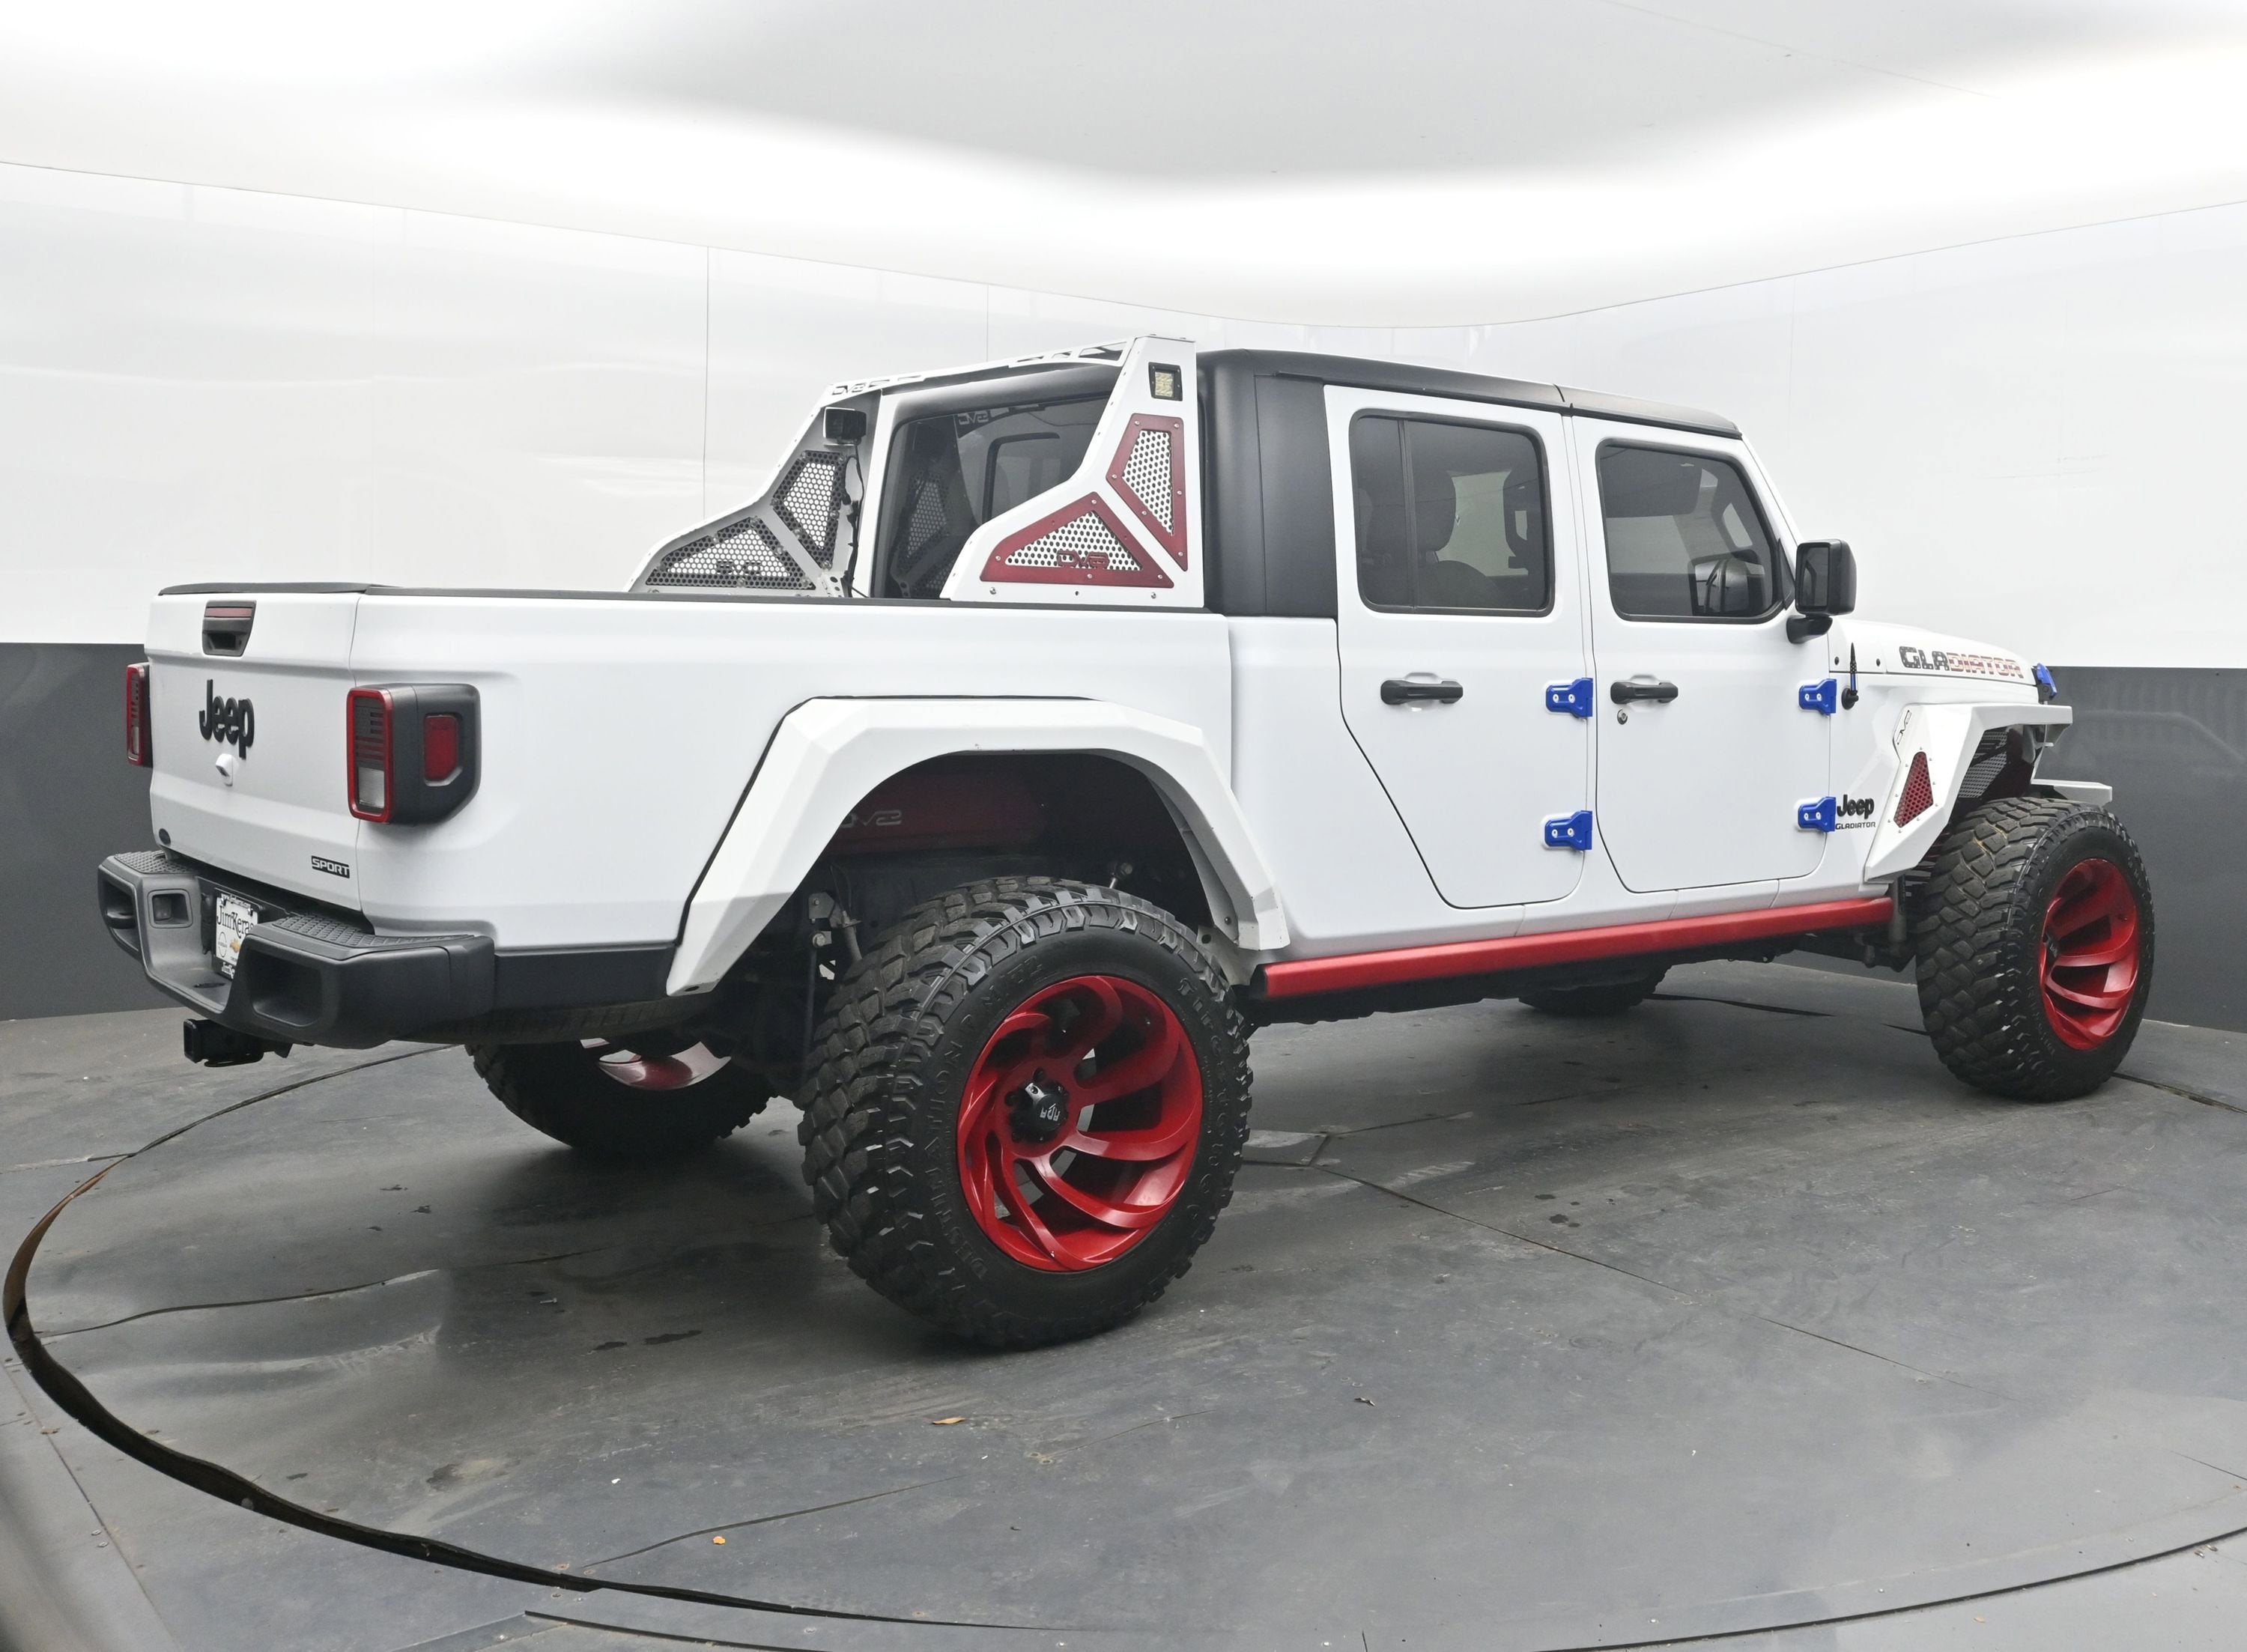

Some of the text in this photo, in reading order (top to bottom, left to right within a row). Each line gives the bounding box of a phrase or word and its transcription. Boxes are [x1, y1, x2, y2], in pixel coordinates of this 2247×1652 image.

[1899, 646, 2024, 678] GLADIATOR
[199, 679, 255, 760] Jeep
[1837, 795, 1875, 820] Jeep
[1835, 822, 1875, 830] GLADIATOR
[312, 857, 349, 876] SPORT
